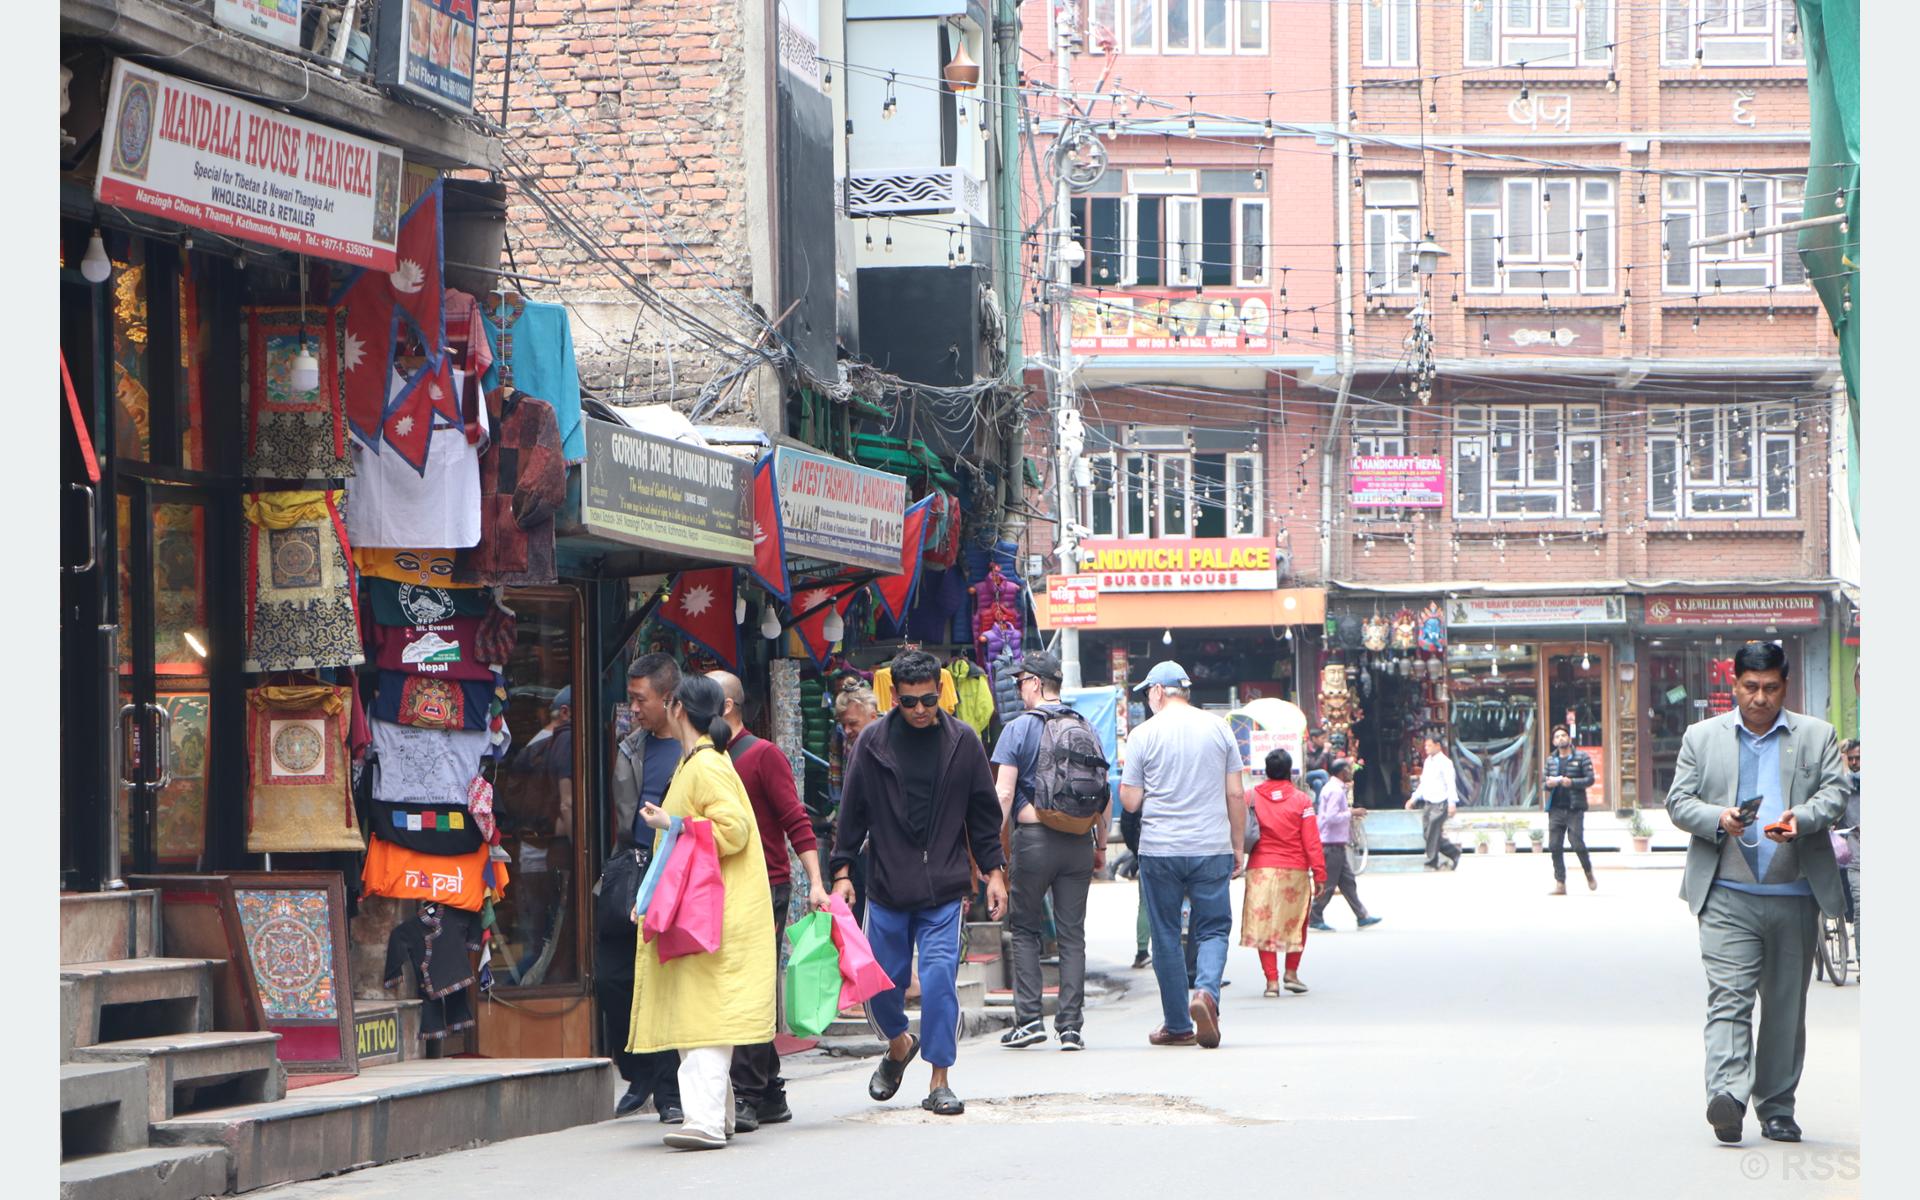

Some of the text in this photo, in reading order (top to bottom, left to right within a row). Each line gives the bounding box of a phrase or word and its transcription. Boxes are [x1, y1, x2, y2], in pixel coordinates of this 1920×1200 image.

[409, 61, 420, 79] 3rd
[421, 67, 438, 87] Floor
[159, 87, 373, 197] MANDALA HOUSE THANGKA
[194, 161, 335, 213] Special for Tibetan & Newari Thangka Art
[136, 189, 172, 210] Narsingh
[174, 198, 203, 219] Chowk,
[205, 207, 235, 227] Thamel,
[235, 215, 278, 239] Kathmandu,
[280, 227, 302, 244] Nepal,
[212, 186, 315, 227] WHOLESALER & RETAILER
[612, 433, 733, 491] GORKHA ZONE KHUKURI HOUSE
[1362, 459, 1414, 470] HANDICRAFT
[1416, 459, 1442, 470] NEPAL
[792, 459, 825, 497] LATEST
[822, 464, 855, 505] FASHION
[862, 474, 905, 516] HANDICRAFTS
[1080, 547, 1271, 571] ANDWICH PALACE
[1181, 573, 1239, 586] HOUSE
[1471, 601, 1484, 609] THE
[1487, 600, 1509, 608] BRAVE
[1580, 598, 1604, 606] HOUSE
[1675, 598, 1682, 609] K
[1687, 598, 1731, 611] JEWELLERY
[1733, 598, 1784, 610] HANDICRAFTS
[1784, 597, 1814, 609] CENTER
[428, 624, 454, 632] Everest
[418, 662, 448, 673] Nepal
[356, 1018, 396, 1055] ATTOO
